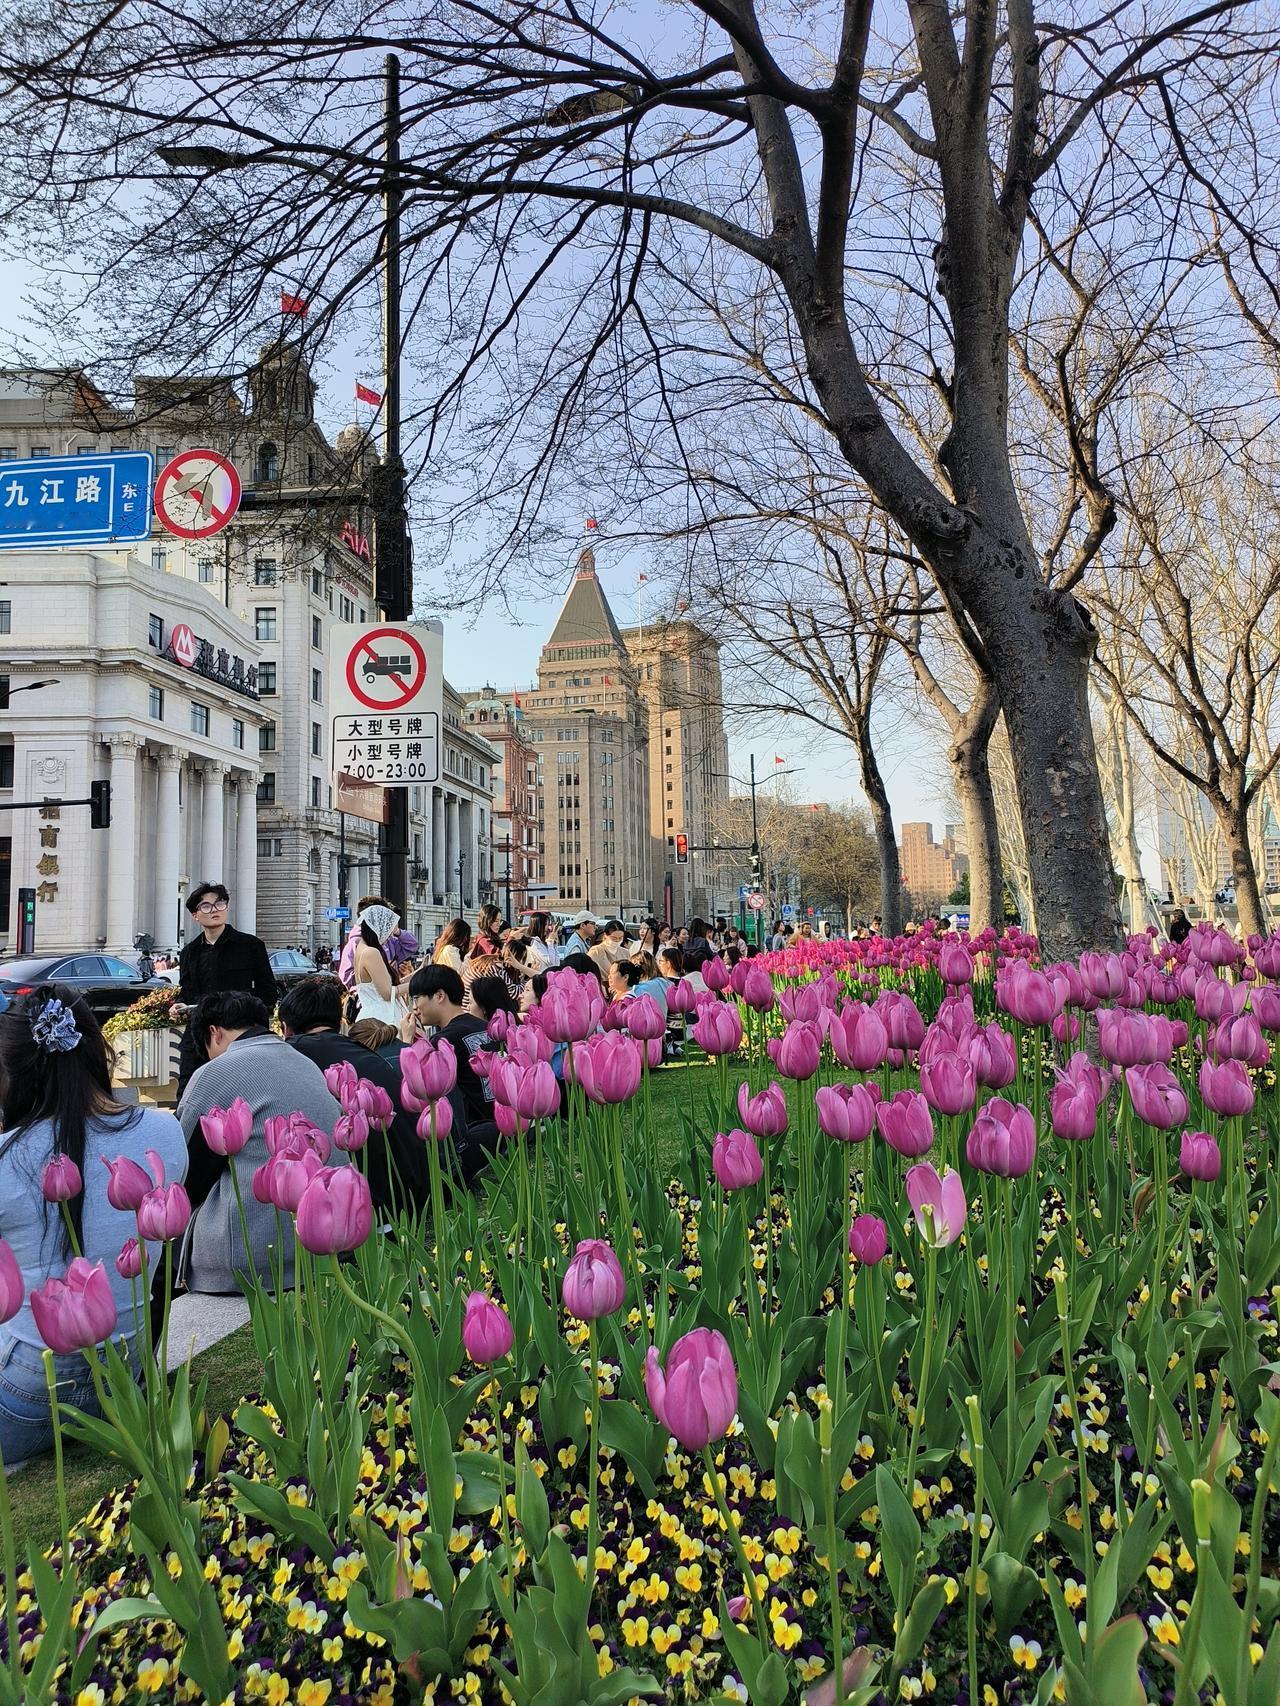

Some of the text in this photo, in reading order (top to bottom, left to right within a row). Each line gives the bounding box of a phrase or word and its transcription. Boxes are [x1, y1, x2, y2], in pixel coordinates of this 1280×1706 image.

[4, 475, 102, 508] 九江路
[121, 482, 138, 499] 东
[123, 502, 135, 512] E
[347, 717, 423, 737] 大型号牌
[347, 742, 423, 761] 小型号牌
[343, 763, 426, 779] 7:00-23:00
